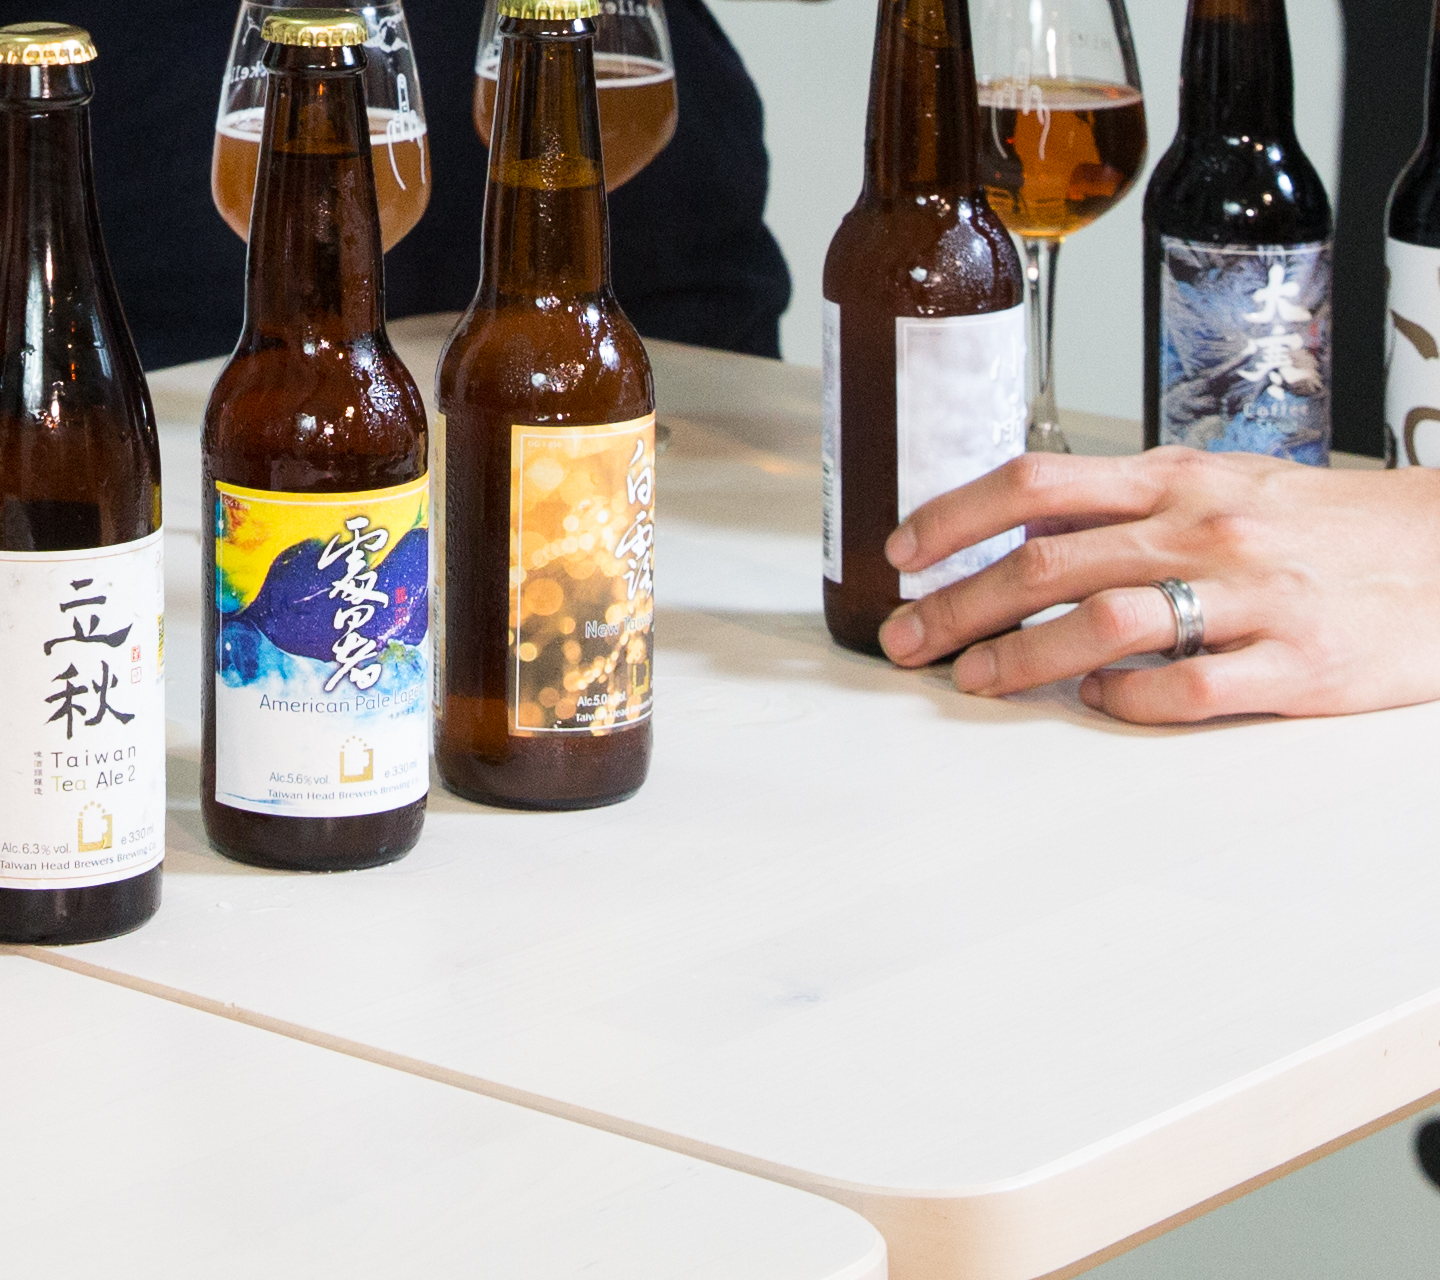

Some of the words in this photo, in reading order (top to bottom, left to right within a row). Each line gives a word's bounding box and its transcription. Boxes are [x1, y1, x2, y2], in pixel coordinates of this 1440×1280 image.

[1237, 264, 1312, 401] 大寒
[585, 620, 619, 639] New
[43, 578, 135, 740] 立秋
[259, 693, 350, 714] American
[355, 692, 390, 711] Pale
[50, 745, 136, 769] Taiwan
[51, 775, 87, 792] Tea
[96, 769, 124, 789] Ale
[127, 764, 136, 782] 2
[268, 788, 303, 800] Taiwan
[307, 791, 335, 800] Head
[339, 788, 378, 800] Brewers
[380, 780, 410, 795] Brewing
[53, 842, 72, 854] vol.
[0, 859, 37, 871] Taiwan
[41, 859, 70, 871] Head
[74, 855, 114, 869] Brewers
[117, 849, 148, 862] Brewing
